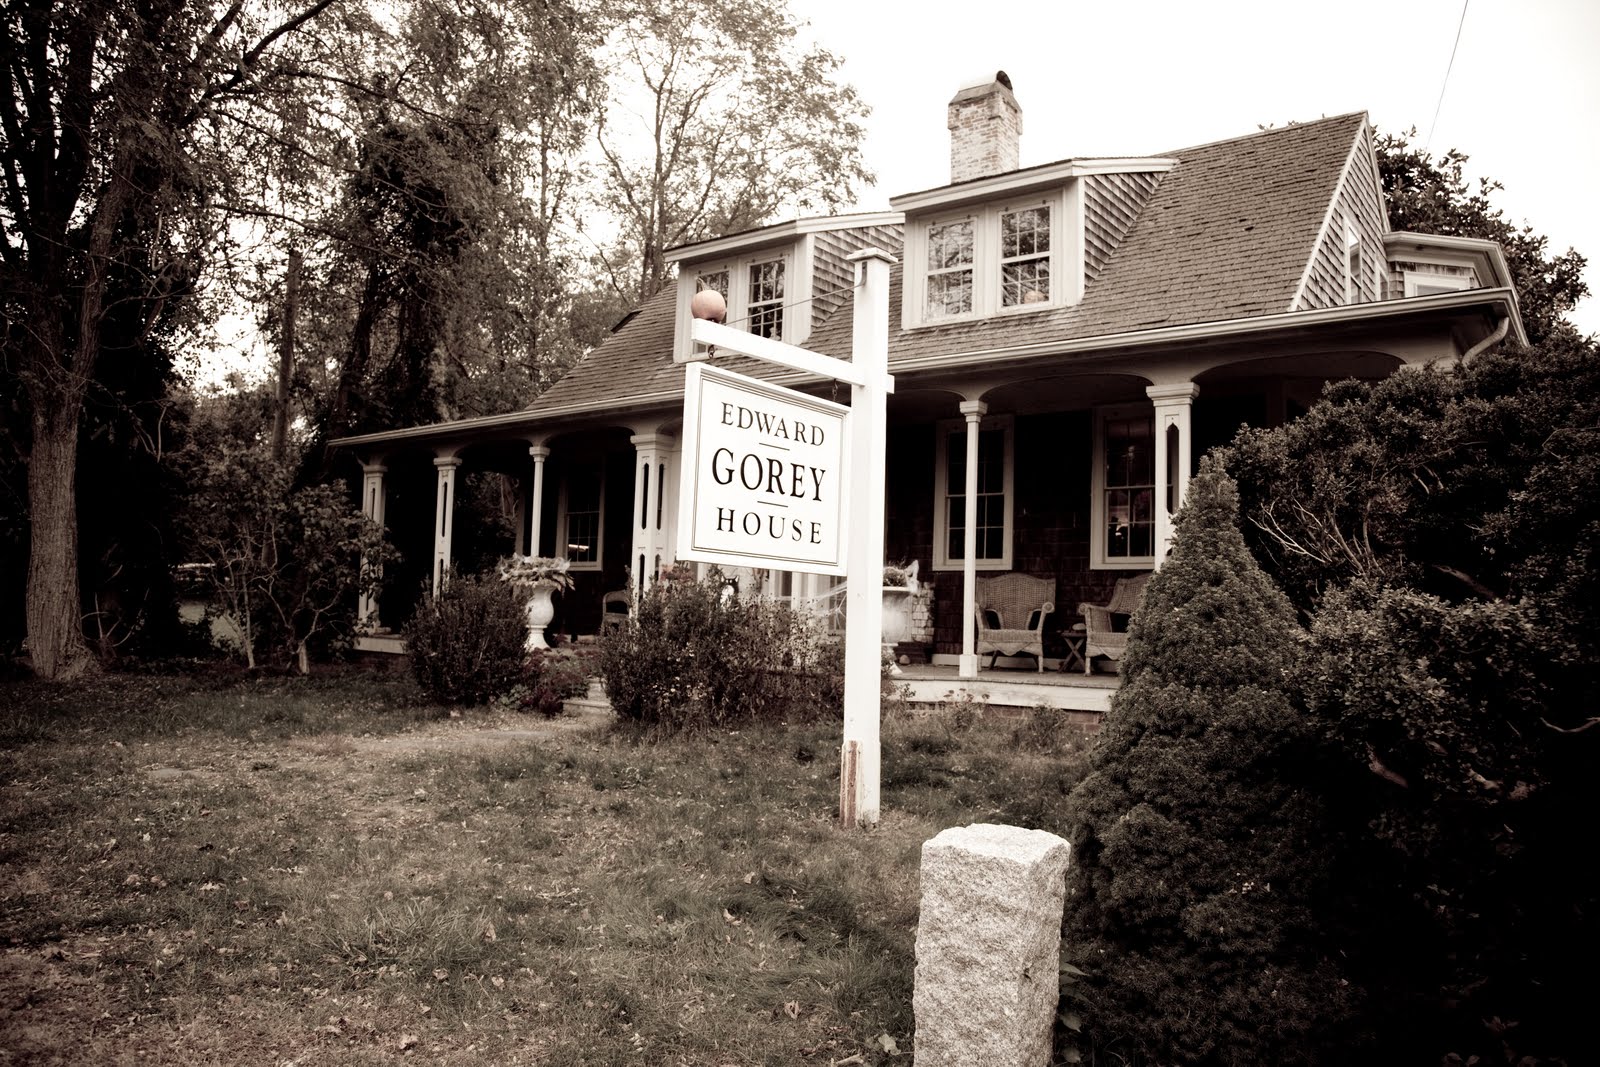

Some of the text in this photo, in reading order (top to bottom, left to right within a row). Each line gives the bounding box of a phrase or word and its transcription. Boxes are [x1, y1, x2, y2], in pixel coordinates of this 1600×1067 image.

[721, 402, 825, 447] EDWARD
[712, 447, 826, 502] GOREY
[716, 507, 822, 545] HOUSE
